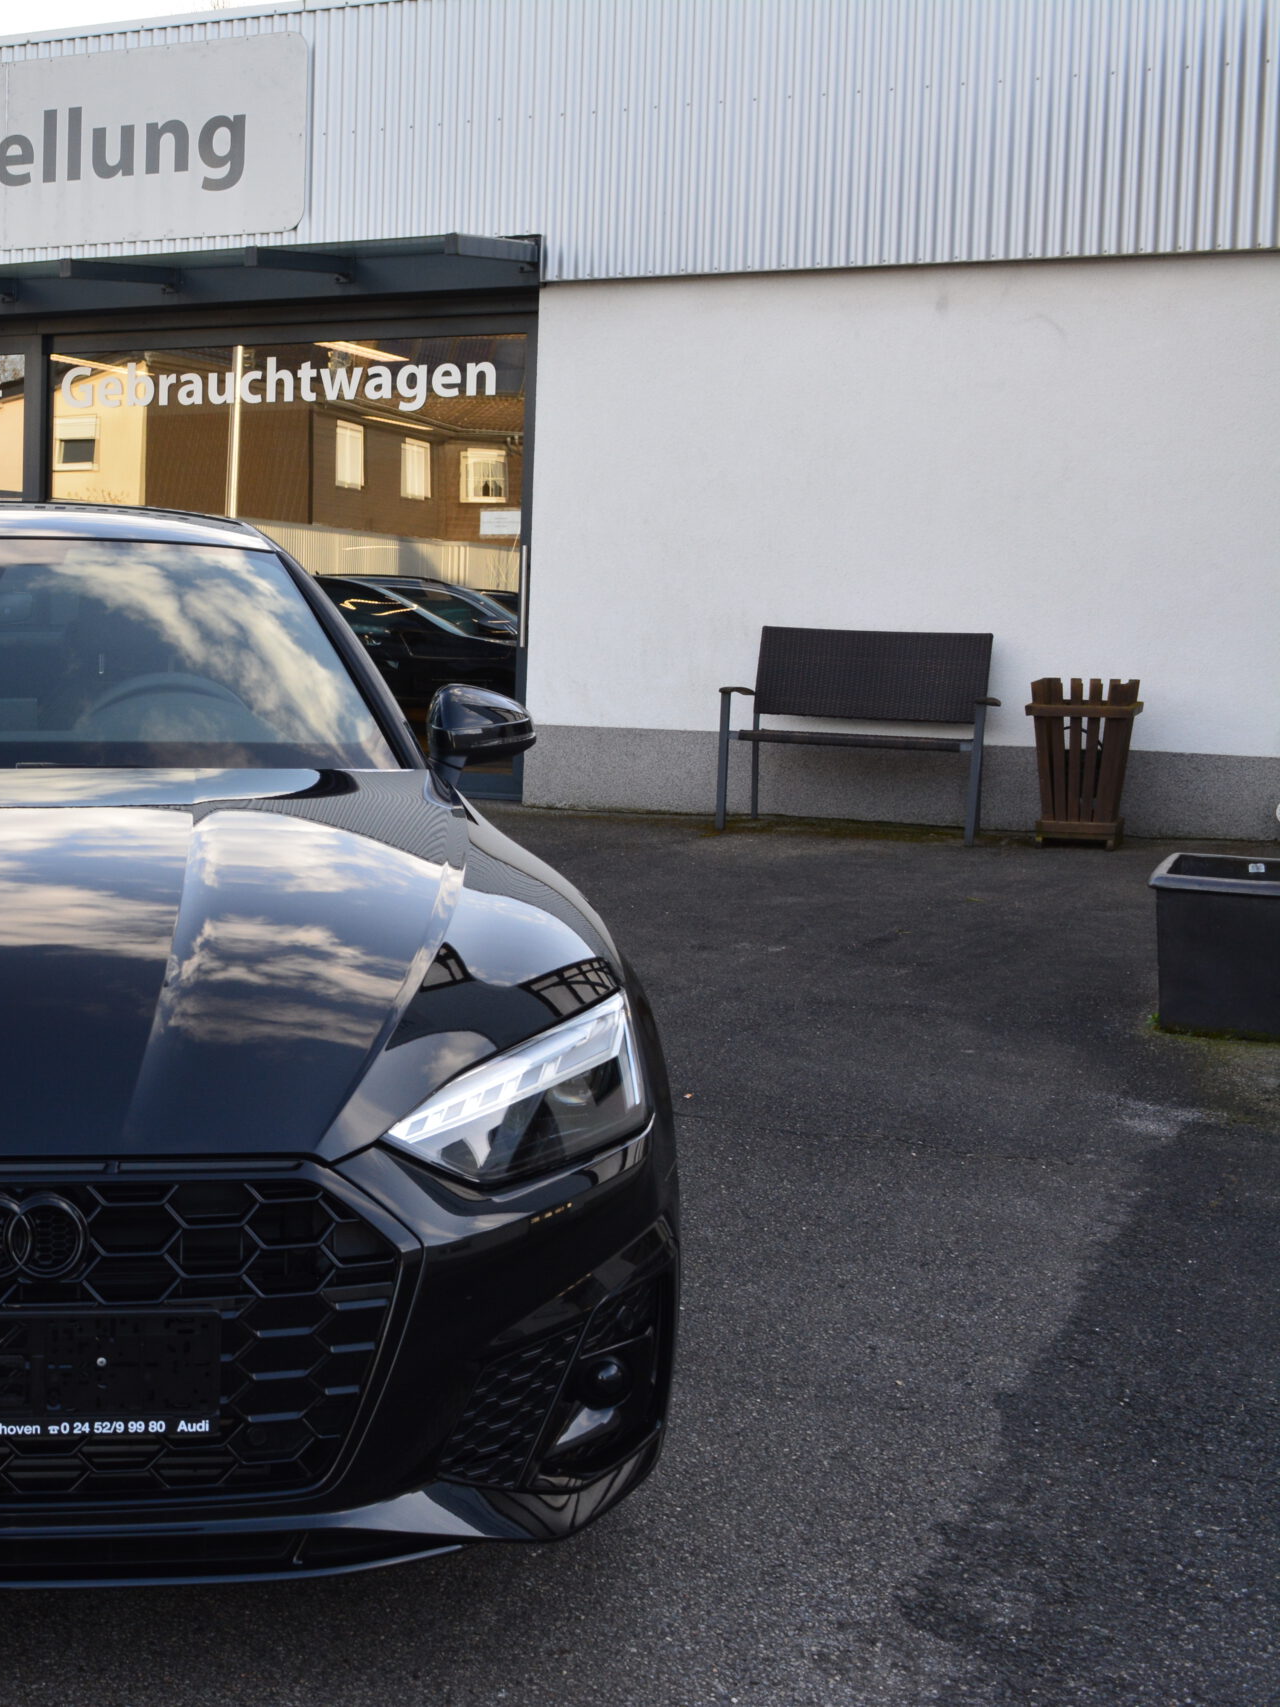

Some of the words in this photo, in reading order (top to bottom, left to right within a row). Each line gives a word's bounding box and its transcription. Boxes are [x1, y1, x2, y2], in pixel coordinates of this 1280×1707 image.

[60, 356, 497, 412] Gebrauchtwagen
[73, 1421, 90, 1434] 24
[93, 1421, 125, 1434] 52/9
[128, 1421, 145, 1433] 99
[148, 1421, 166, 1433] 80
[177, 1419, 210, 1433] Audi
